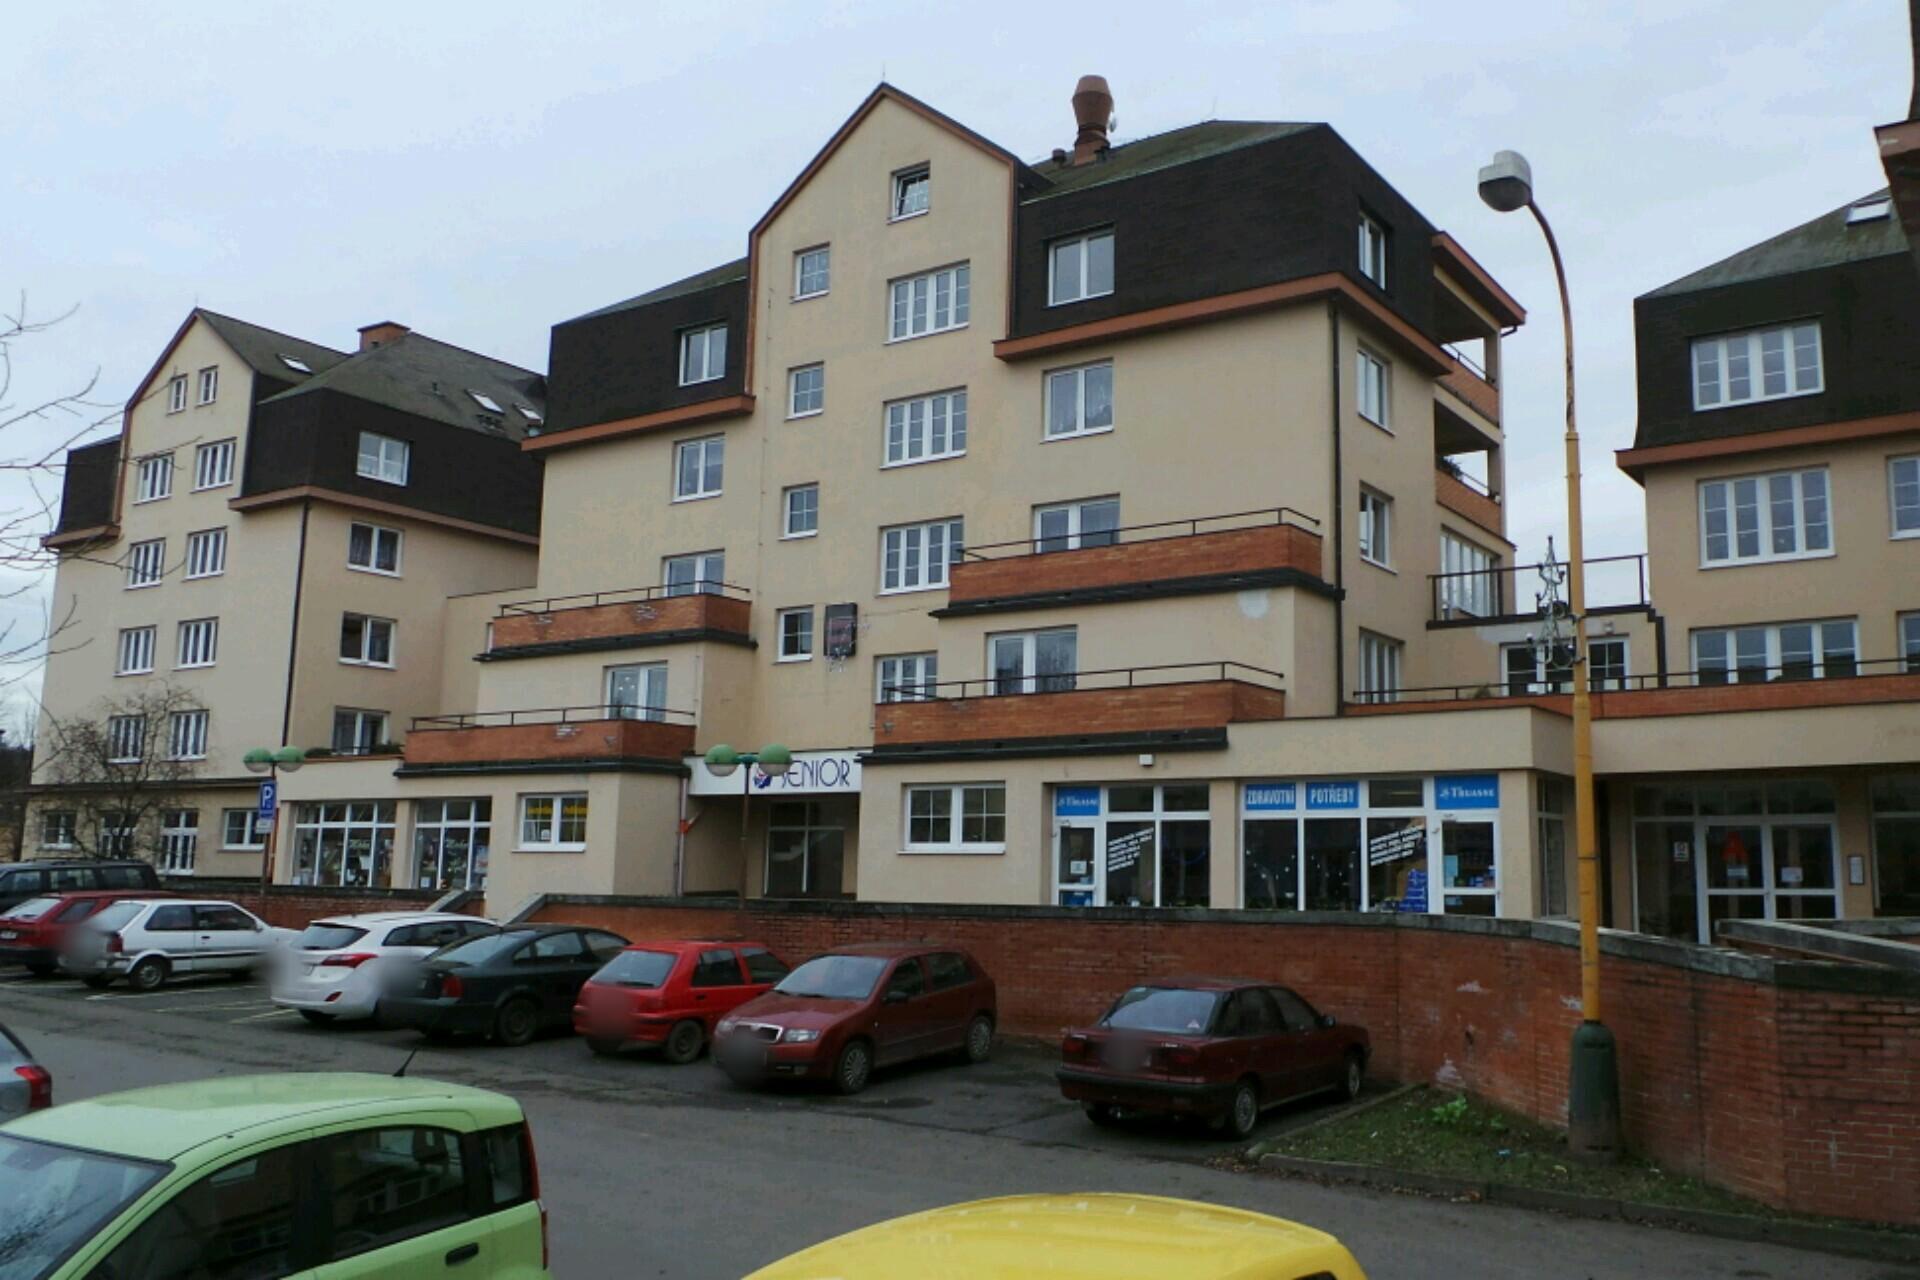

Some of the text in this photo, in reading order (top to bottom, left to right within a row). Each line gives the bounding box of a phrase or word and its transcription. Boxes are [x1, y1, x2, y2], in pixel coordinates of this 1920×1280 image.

[262, 785, 273, 808] P
[1246, 784, 1356, 805] ZDRAVOTNÍ POTŘEBY
